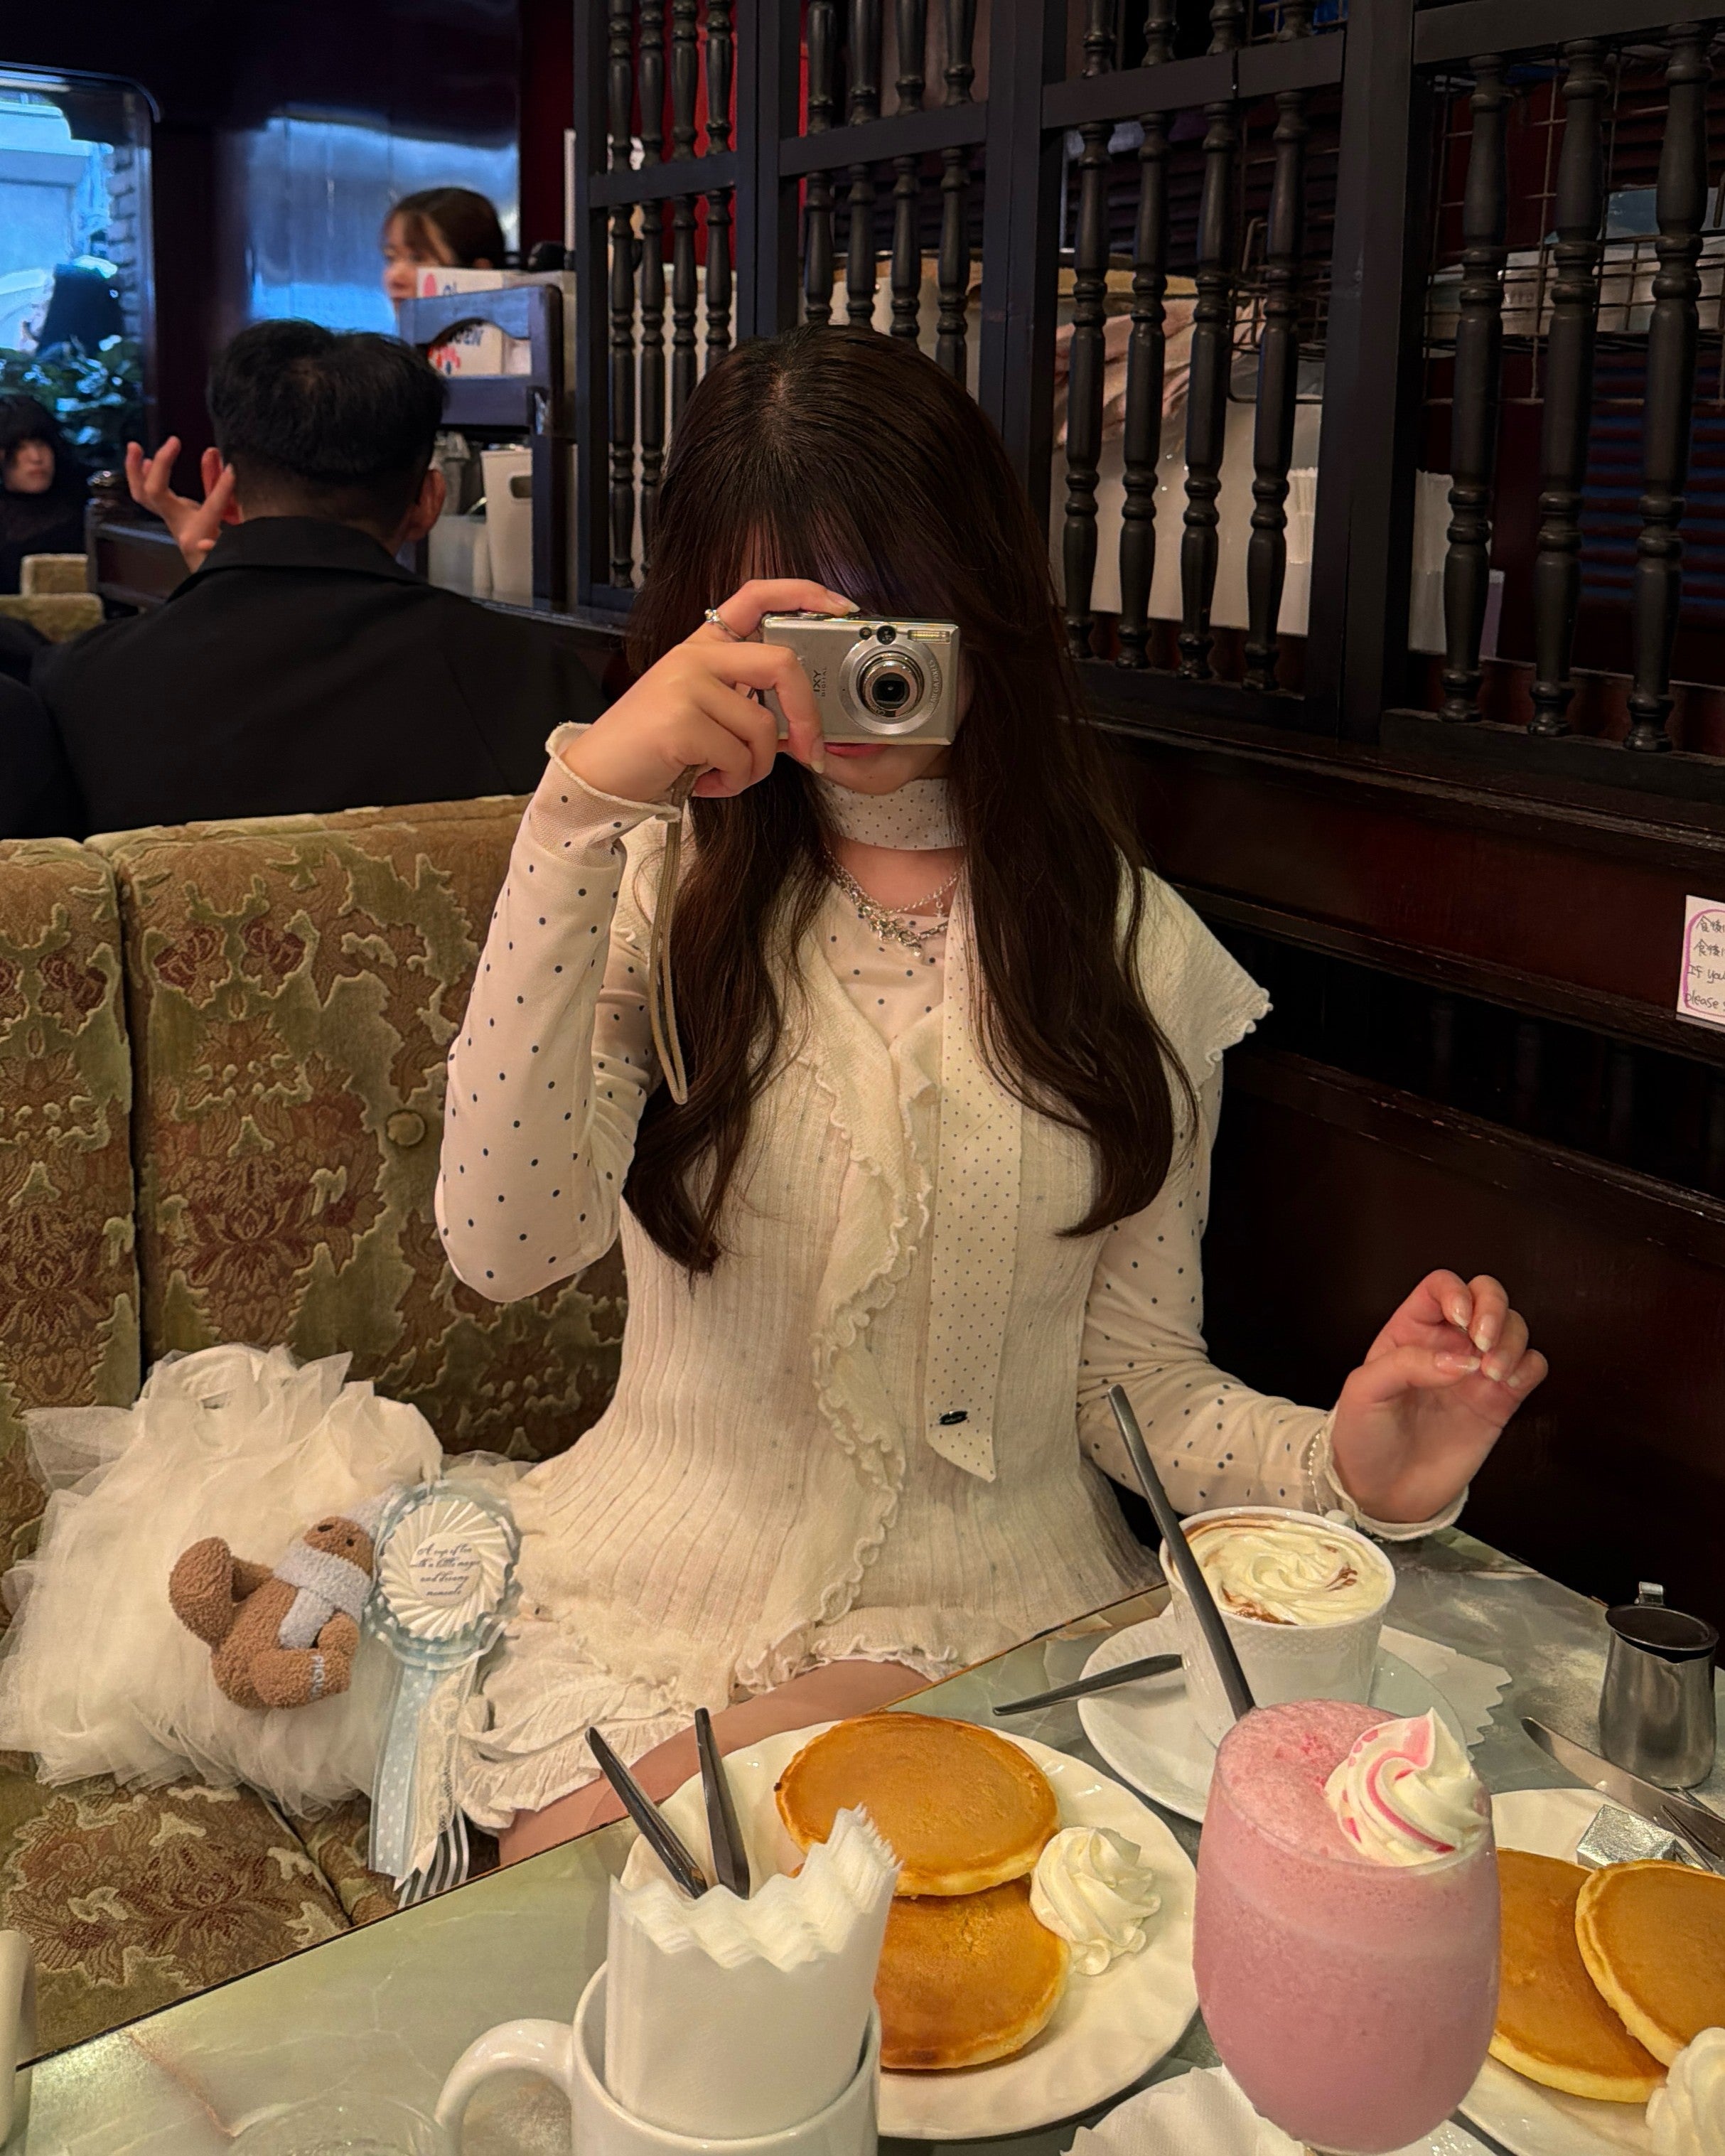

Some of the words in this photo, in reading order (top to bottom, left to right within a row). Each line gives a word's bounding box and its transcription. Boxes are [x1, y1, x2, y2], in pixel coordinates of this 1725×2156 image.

[812, 670, 822, 692] IXY
[1687, 964, 1703, 979] If
[1684, 989, 1719, 1009] please
[416, 1543, 435, 1556] A
[436, 1557, 460, 1568] little
[420, 1571, 446, 1582] and
